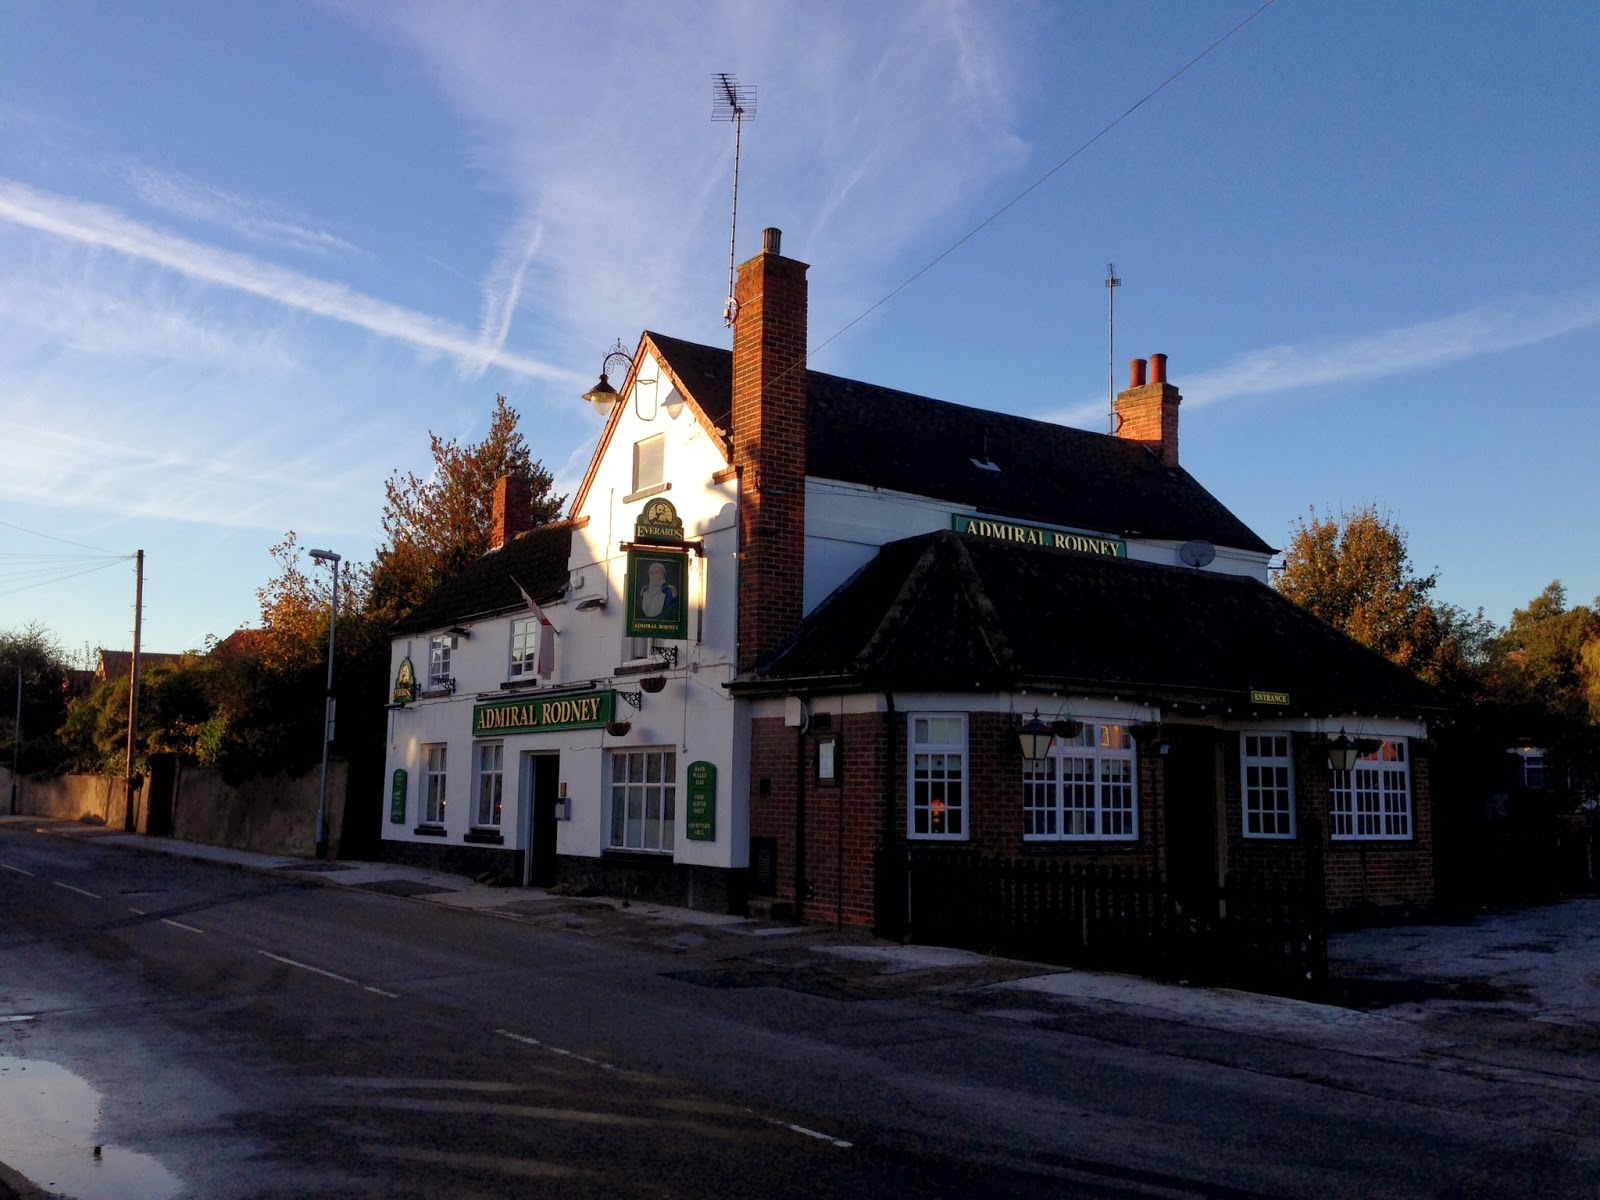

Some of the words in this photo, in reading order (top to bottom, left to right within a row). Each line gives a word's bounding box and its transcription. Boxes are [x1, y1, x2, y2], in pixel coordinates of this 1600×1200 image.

[637, 526, 683, 540] EVERARDS
[967, 520, 1049, 546] ADMIRAL
[1054, 533, 1120, 557] RODNEY
[1254, 693, 1287, 703] ENTRANCE
[477, 704, 537, 729] ADMIRAL
[542, 698, 600, 724] RODNEY
